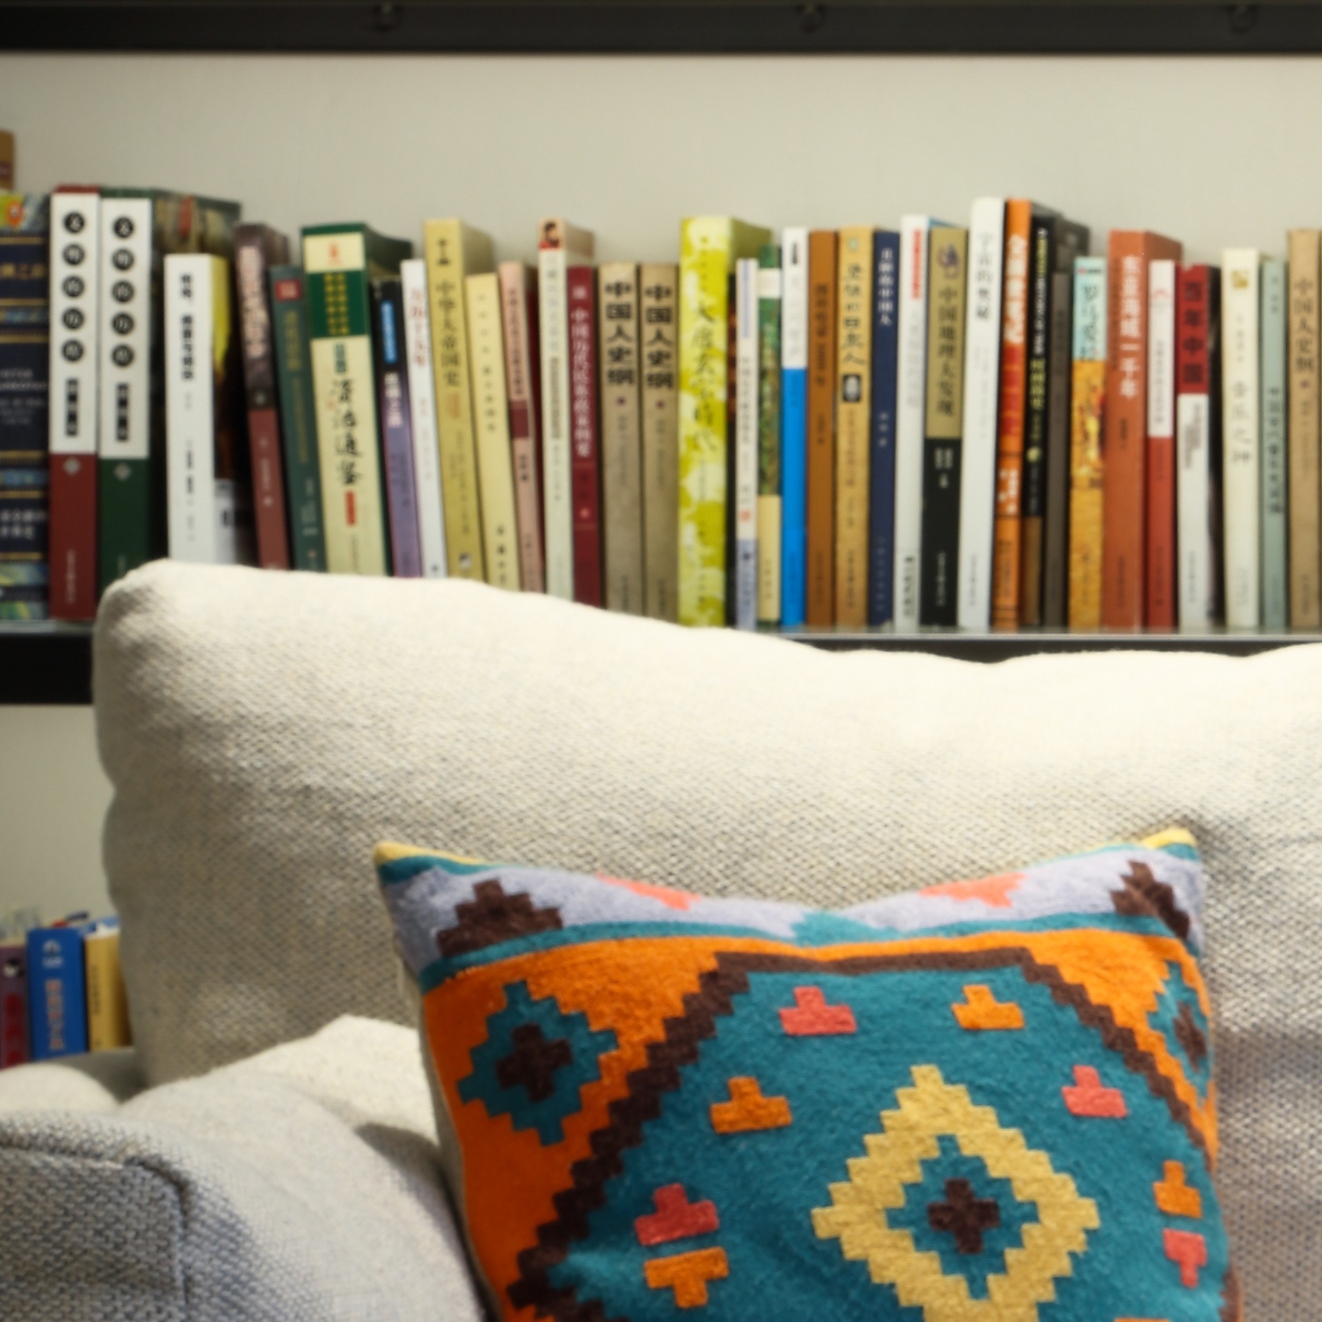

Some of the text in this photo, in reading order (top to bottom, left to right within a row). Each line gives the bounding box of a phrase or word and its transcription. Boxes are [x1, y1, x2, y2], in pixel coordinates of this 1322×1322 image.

[604, 281, 635, 387] 中国人史纲
[645, 283, 675, 391] 中国人史纲
